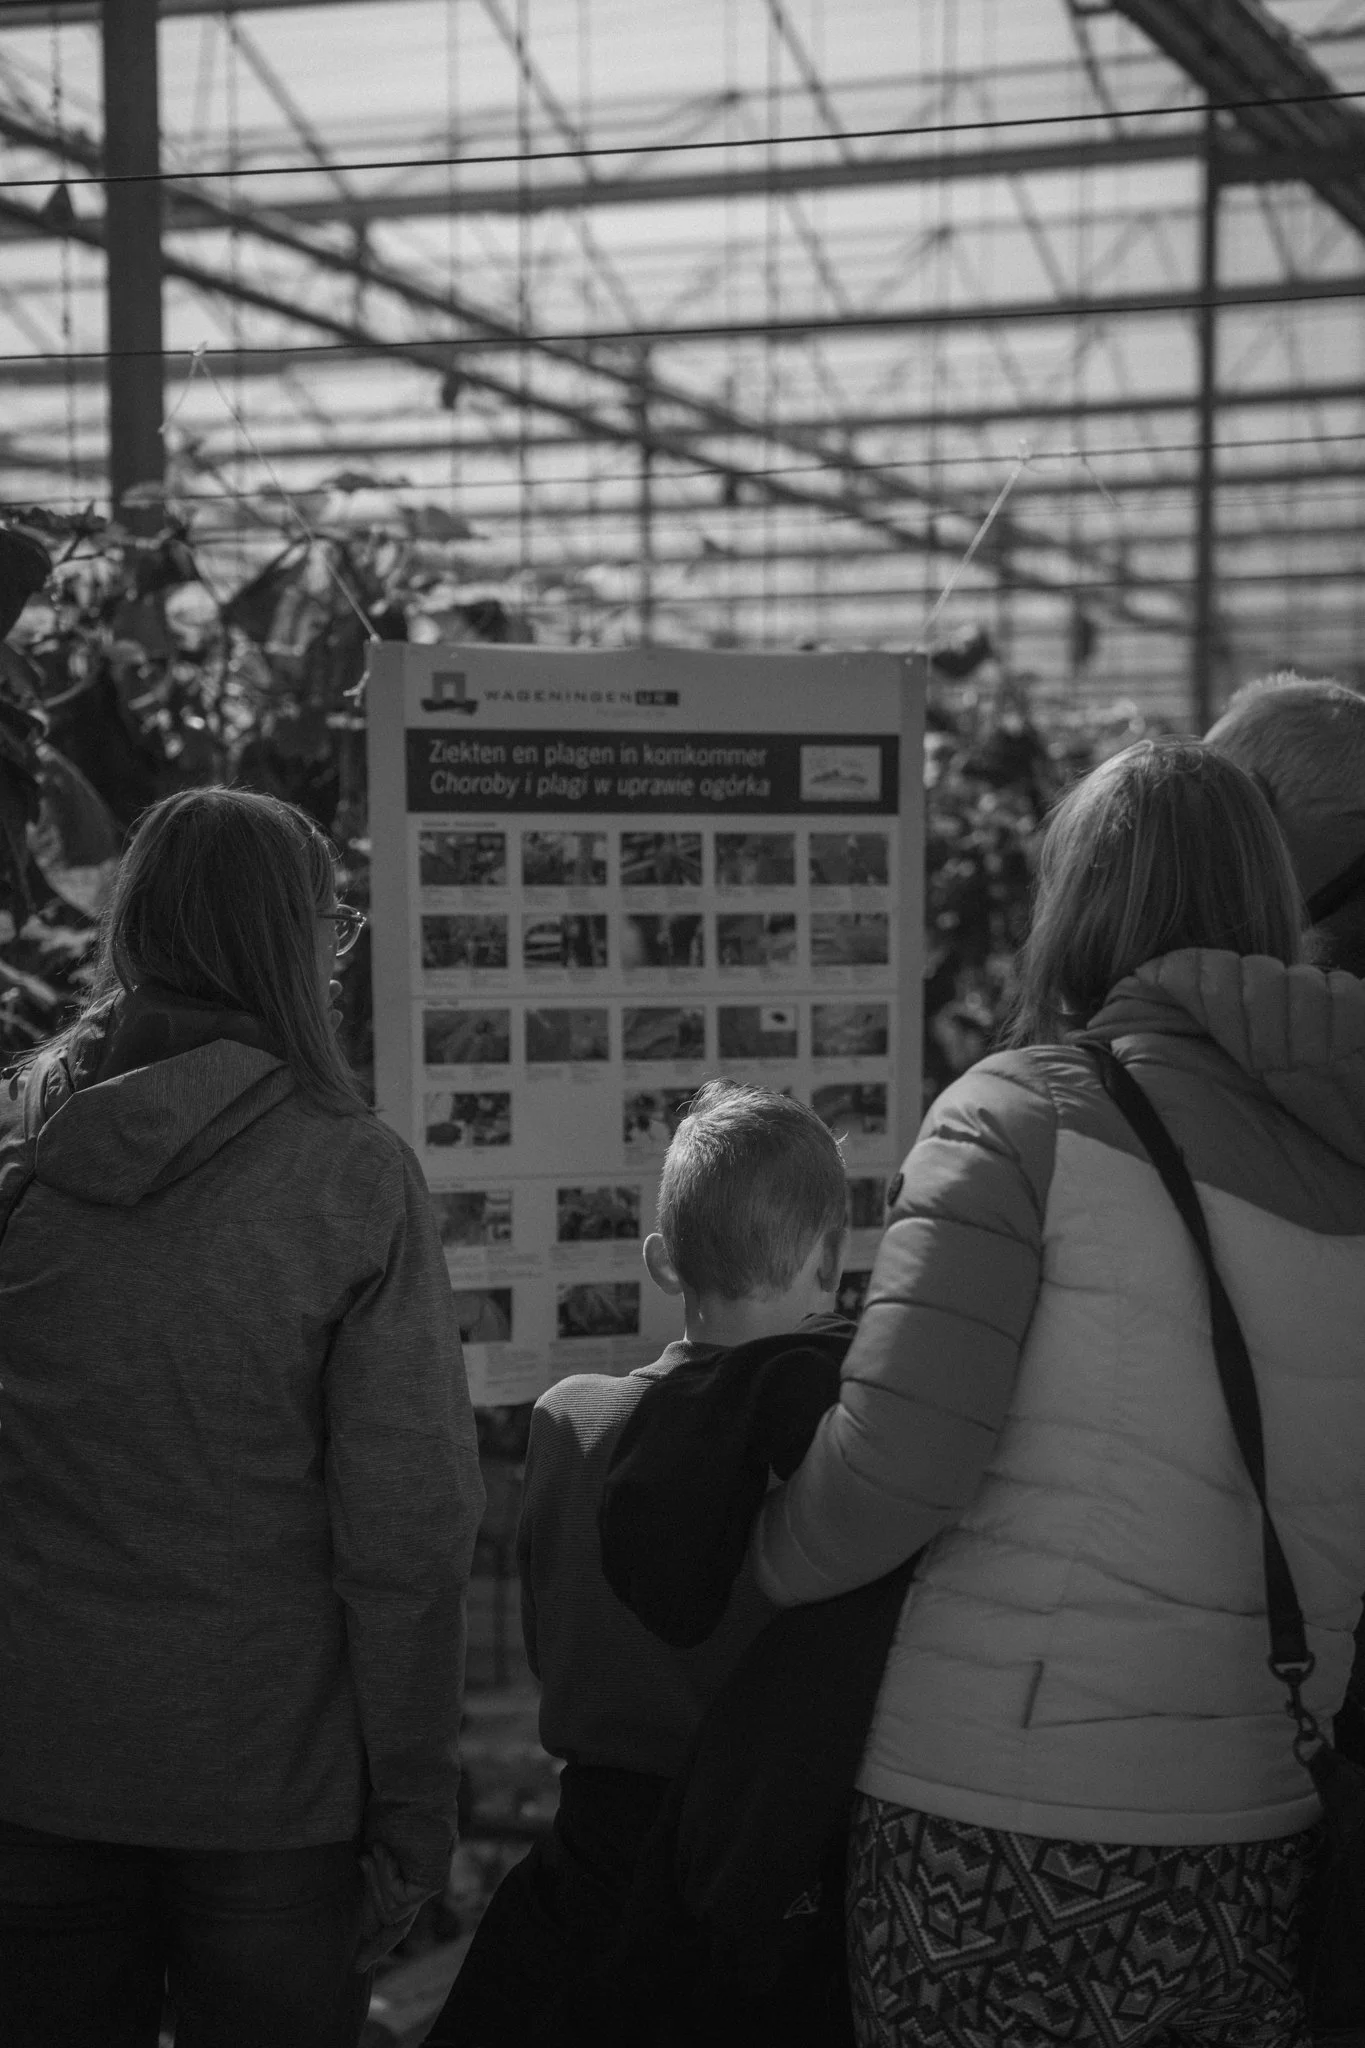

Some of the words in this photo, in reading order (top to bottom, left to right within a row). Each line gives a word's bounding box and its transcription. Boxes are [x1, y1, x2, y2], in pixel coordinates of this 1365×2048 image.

[484, 690, 632, 704] WAGENINGEN
[429, 739, 506, 764] Ziekten
[512, 745, 538, 765] en
[544, 741, 616, 770] plagen
[620, 742, 638, 766] in
[643, 743, 767, 767] komkommer
[430, 771, 519, 800] Choroby
[525, 773, 533, 795] i
[536, 775, 589, 800] plagi
[594, 778, 612, 796] w
[617, 775, 694, 800] uprawie
[699, 774, 771, 801] ogórka
